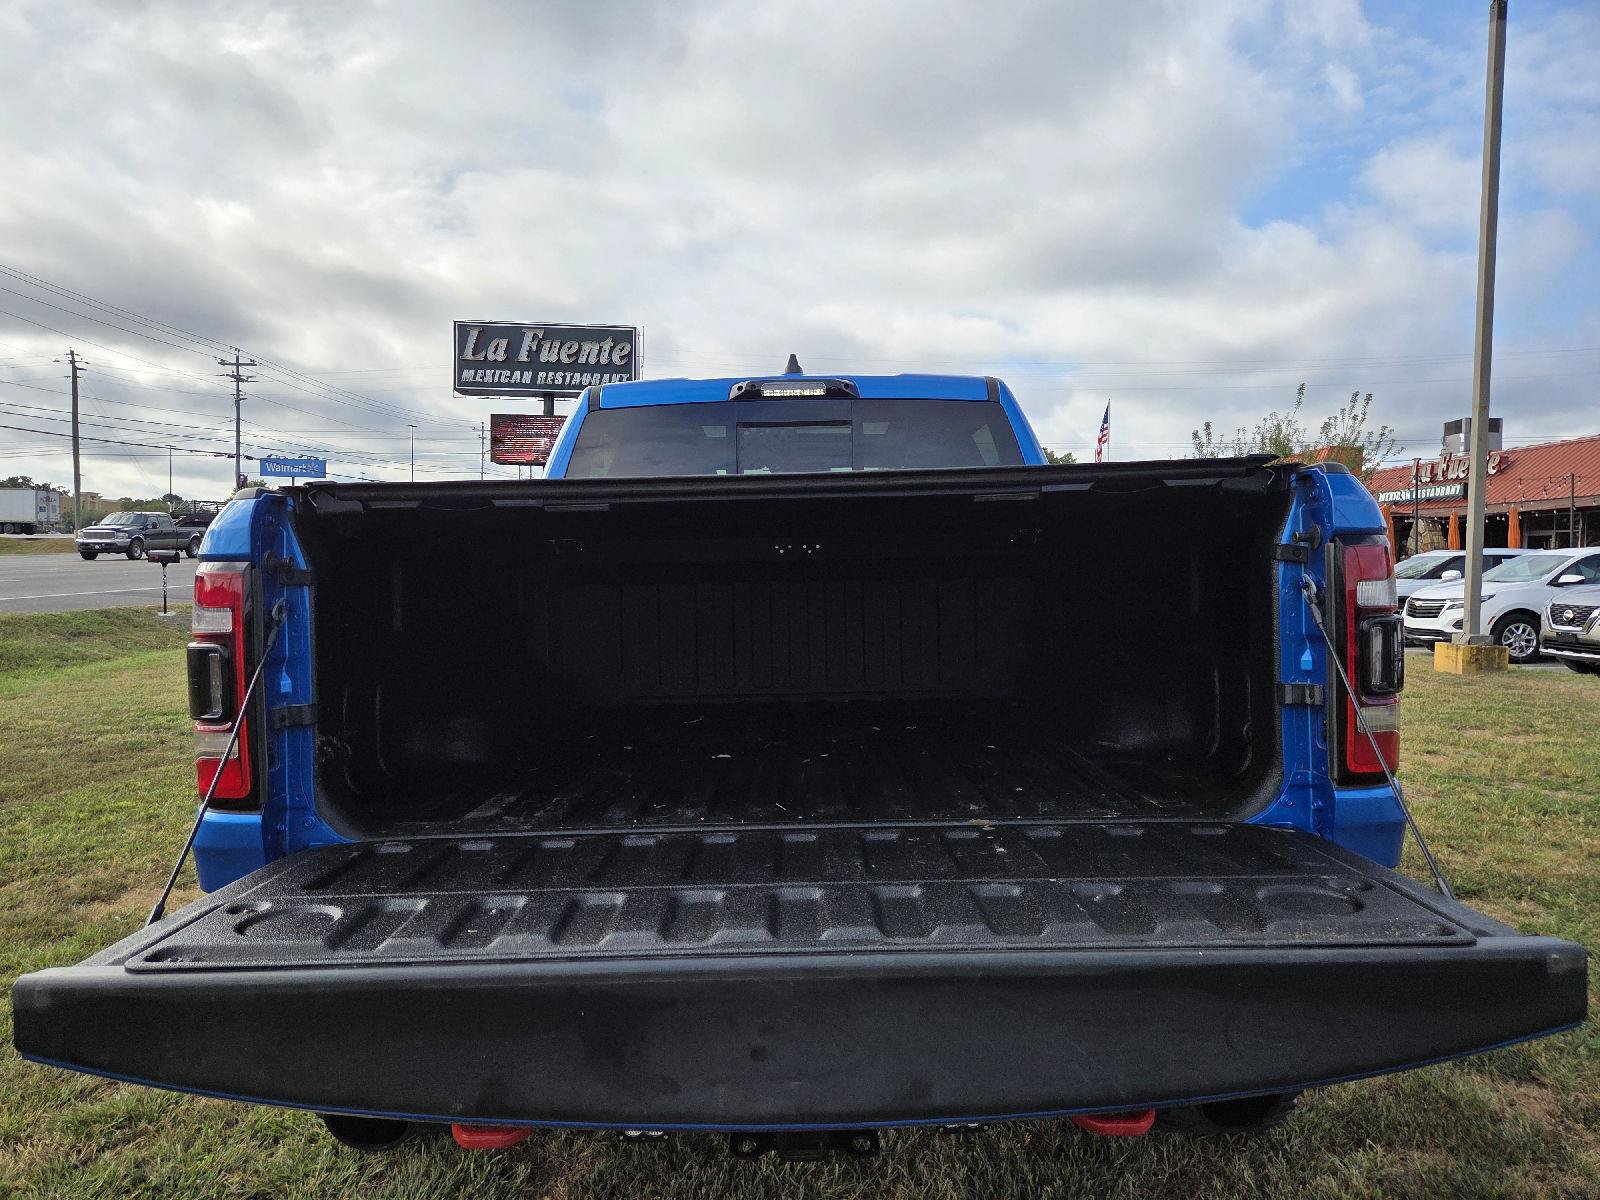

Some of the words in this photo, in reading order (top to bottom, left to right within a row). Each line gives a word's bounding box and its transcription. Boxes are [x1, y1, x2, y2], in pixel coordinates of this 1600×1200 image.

[460, 327, 509, 362] La
[515, 328, 632, 366] Fuente
[461, 369, 533, 384] MEXICAN
[537, 371, 630, 386] RESTAURANT
[266, 462, 307, 473] Walmart
[1437, 452, 1501, 480] Fuee
[1378, 489, 1411, 502] MEXICAN
